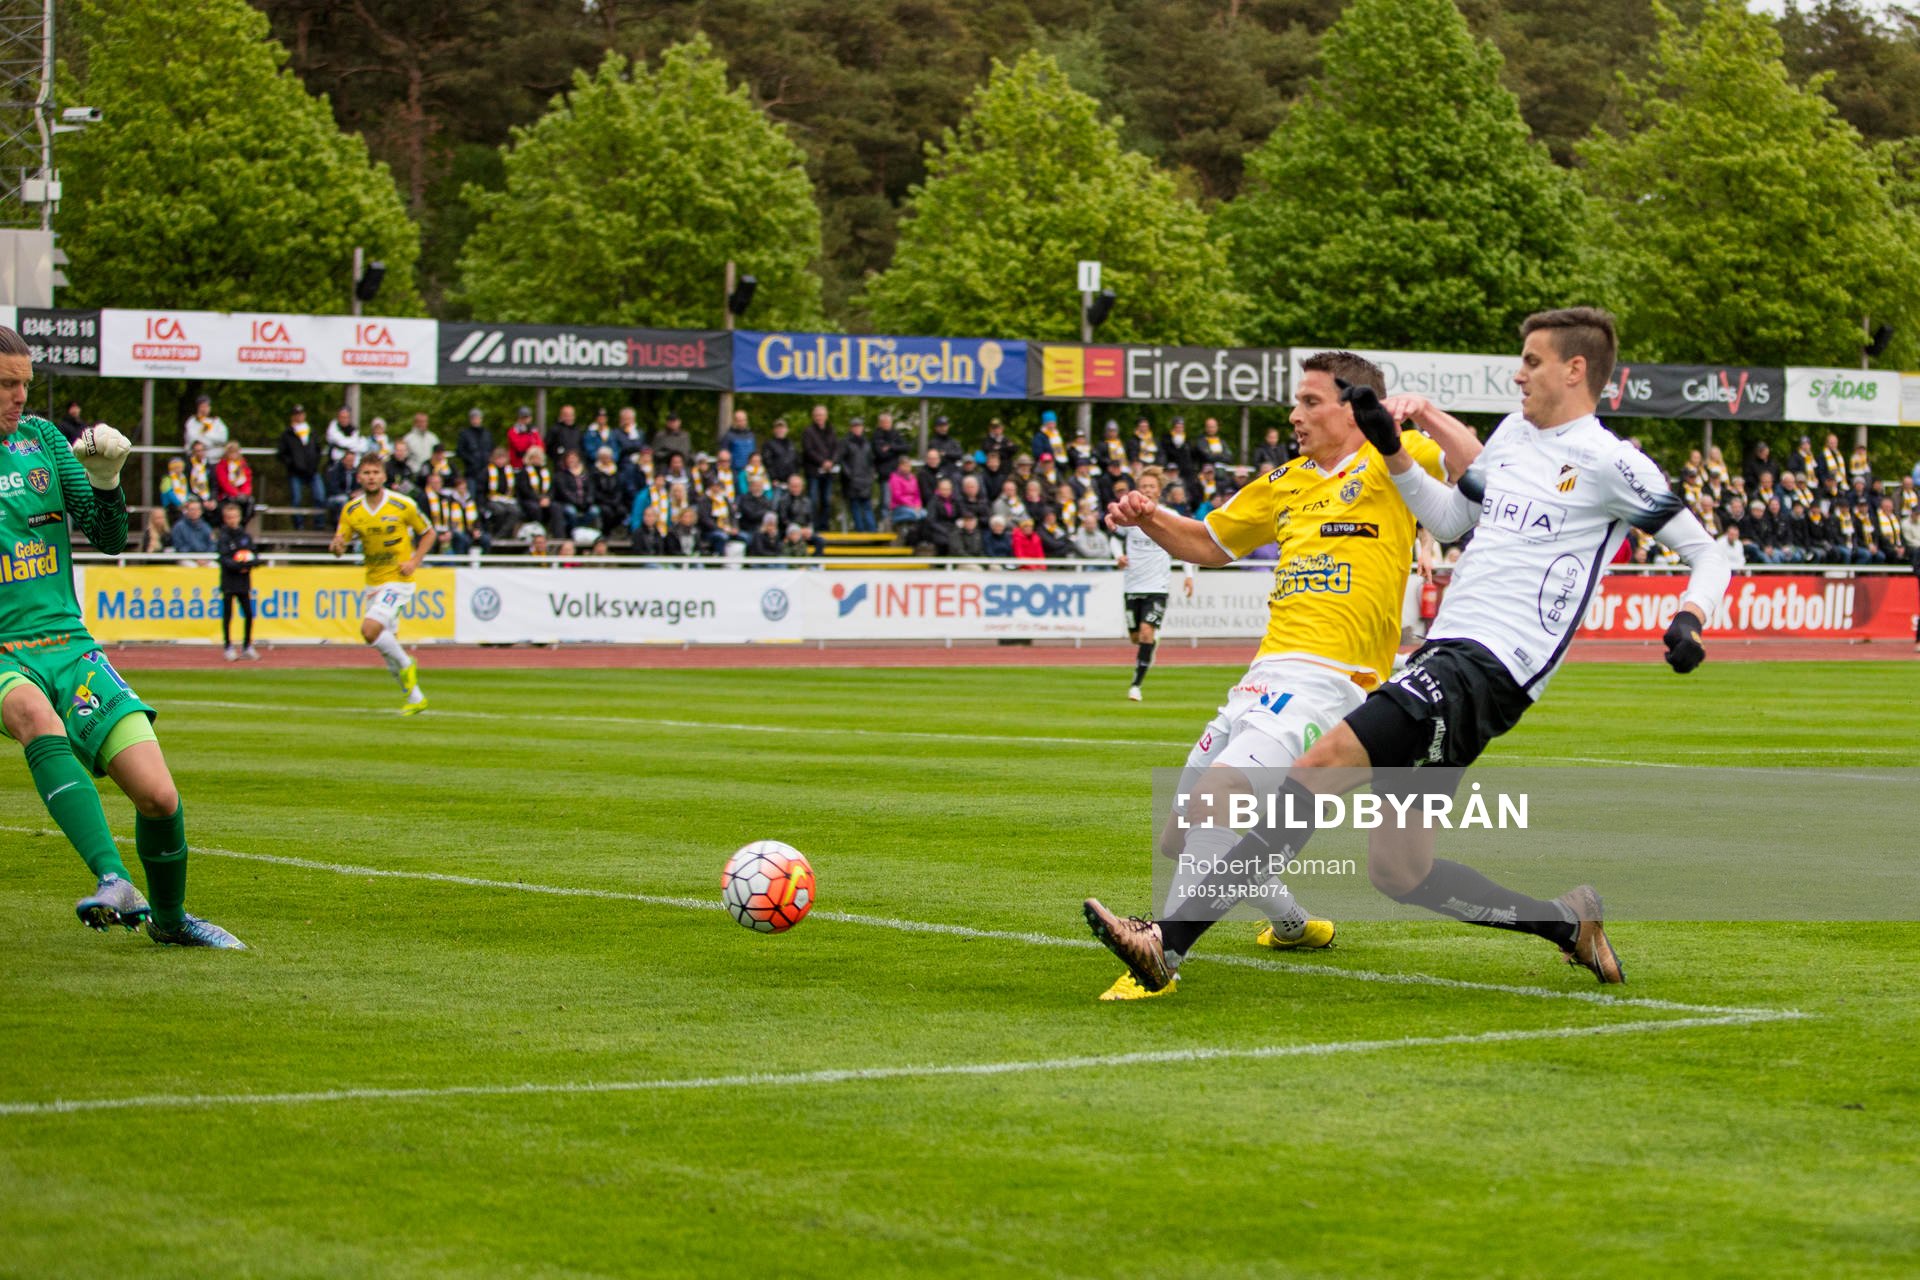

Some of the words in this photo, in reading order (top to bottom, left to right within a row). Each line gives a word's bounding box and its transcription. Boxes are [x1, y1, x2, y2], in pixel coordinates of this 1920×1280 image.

[146, 317, 186, 340] ICA
[252, 320, 291, 344] ICA
[356, 323, 395, 347] ICA
[135, 346, 199, 360] KVANTUM
[240, 349, 305, 362] KVANTUM
[511, 333, 708, 369] motionshuset
[757, 334, 850, 380] Guld
[857, 337, 975, 395] Fågeln
[1126, 349, 1290, 402] Eirefelt
[1377, 361, 1473, 405] Design
[96, 587, 299, 620] Måååååid!!
[547, 592, 716, 625] Volkswagen
[875, 583, 1092, 618] INTERSPORT
[1546, 565, 1579, 624] BOHUS
[1584, 583, 1623, 631] ör
[1624, 594, 1733, 631] svek
[1738, 582, 1856, 631] fotboll!
